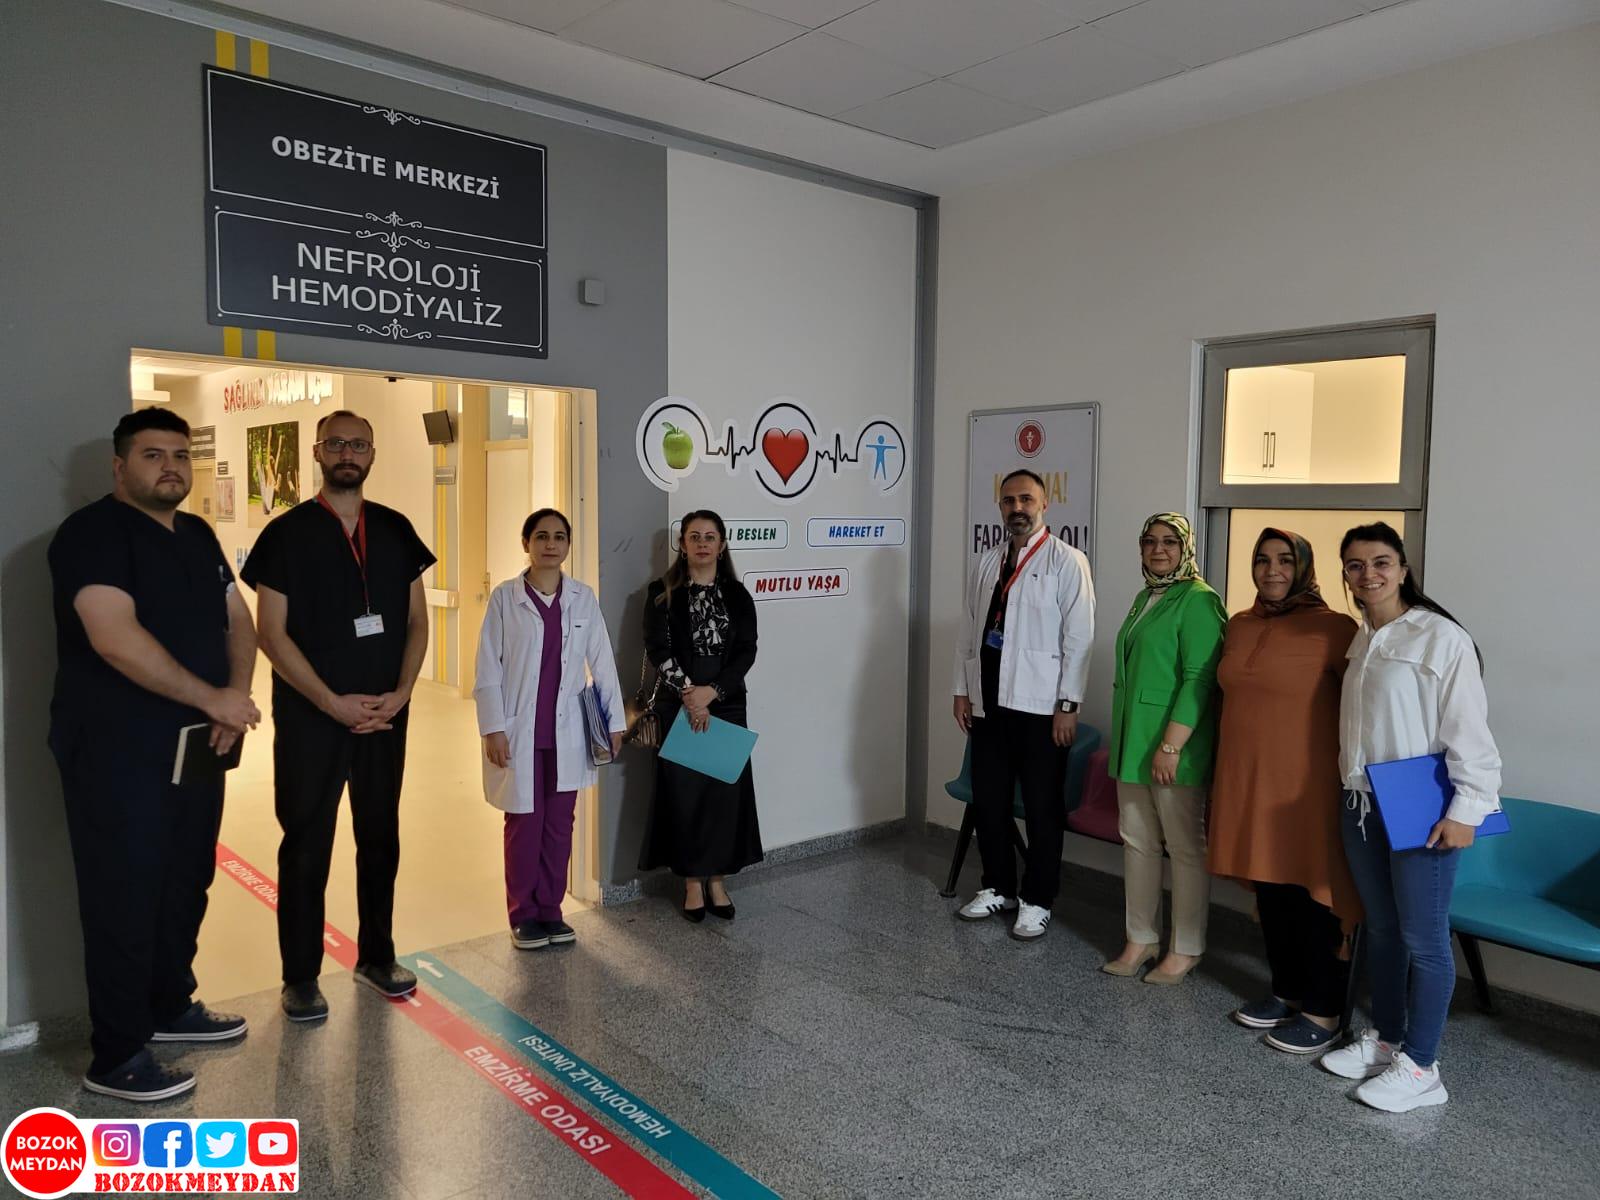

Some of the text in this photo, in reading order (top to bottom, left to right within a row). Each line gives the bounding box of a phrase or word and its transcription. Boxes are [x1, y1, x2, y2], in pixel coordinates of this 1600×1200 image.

[271, 135, 500, 200] OBEZİTE MERKEZİ
[297, 242, 481, 293] NEFROLOJİ
[271, 275, 503, 328] HEMODİYALİZ
[736, 527, 777, 541] BESLEN
[828, 525, 885, 538] HAREKET ET
[755, 575, 841, 594] MUTLU YAŞA
[463, 1045, 613, 1156] EMZİRME ODASI
[518, 1034, 672, 1140] HEMODİYALİZ ÜNİTESİ
